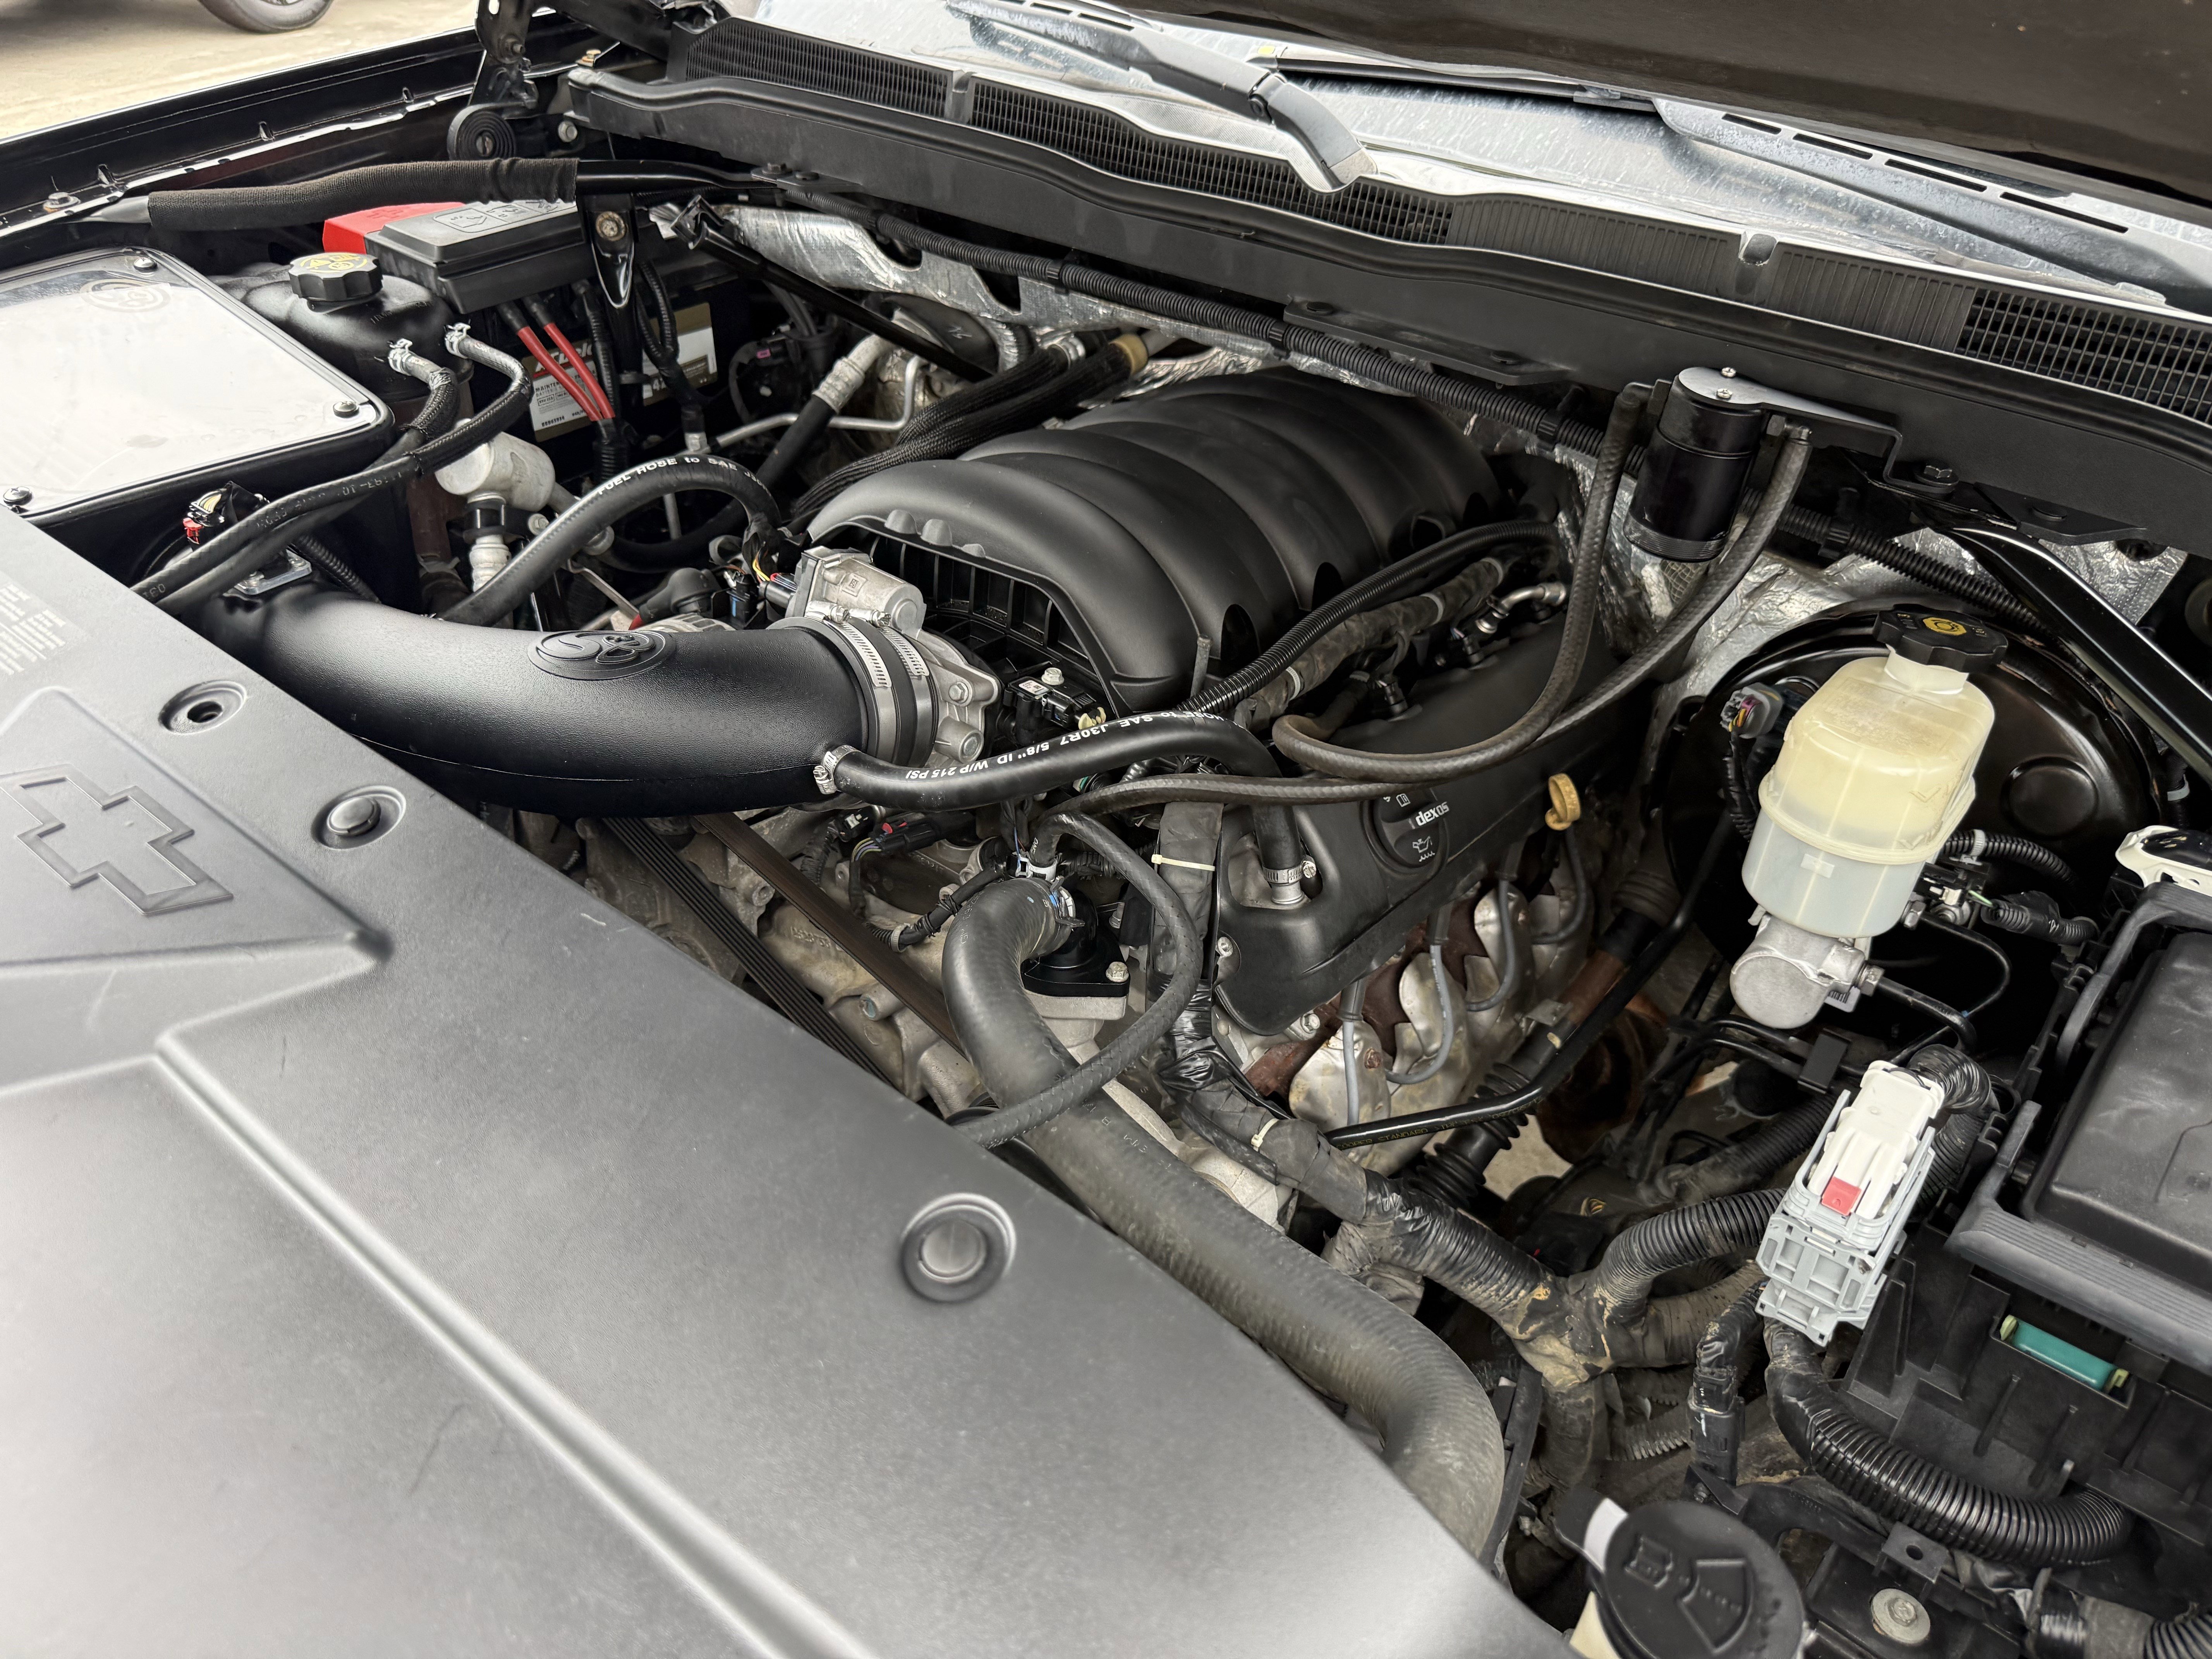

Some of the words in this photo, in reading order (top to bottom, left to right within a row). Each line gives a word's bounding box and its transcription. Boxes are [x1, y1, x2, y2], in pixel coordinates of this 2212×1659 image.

[597, 473, 631, 495] FUEL
[636, 457, 678, 475] HOSE
[708, 457, 738, 471] SAE
[1120, 714, 1153, 728] SAE
[1182, 711, 1224, 721] HOSE
[1060, 723, 1109, 745] J30R7
[997, 754, 1013, 764] ID
[931, 766, 957, 778] 215
[959, 760, 989, 774] W/P
[905, 770, 929, 779] PSI
[1415, 801, 1450, 826] dexos
